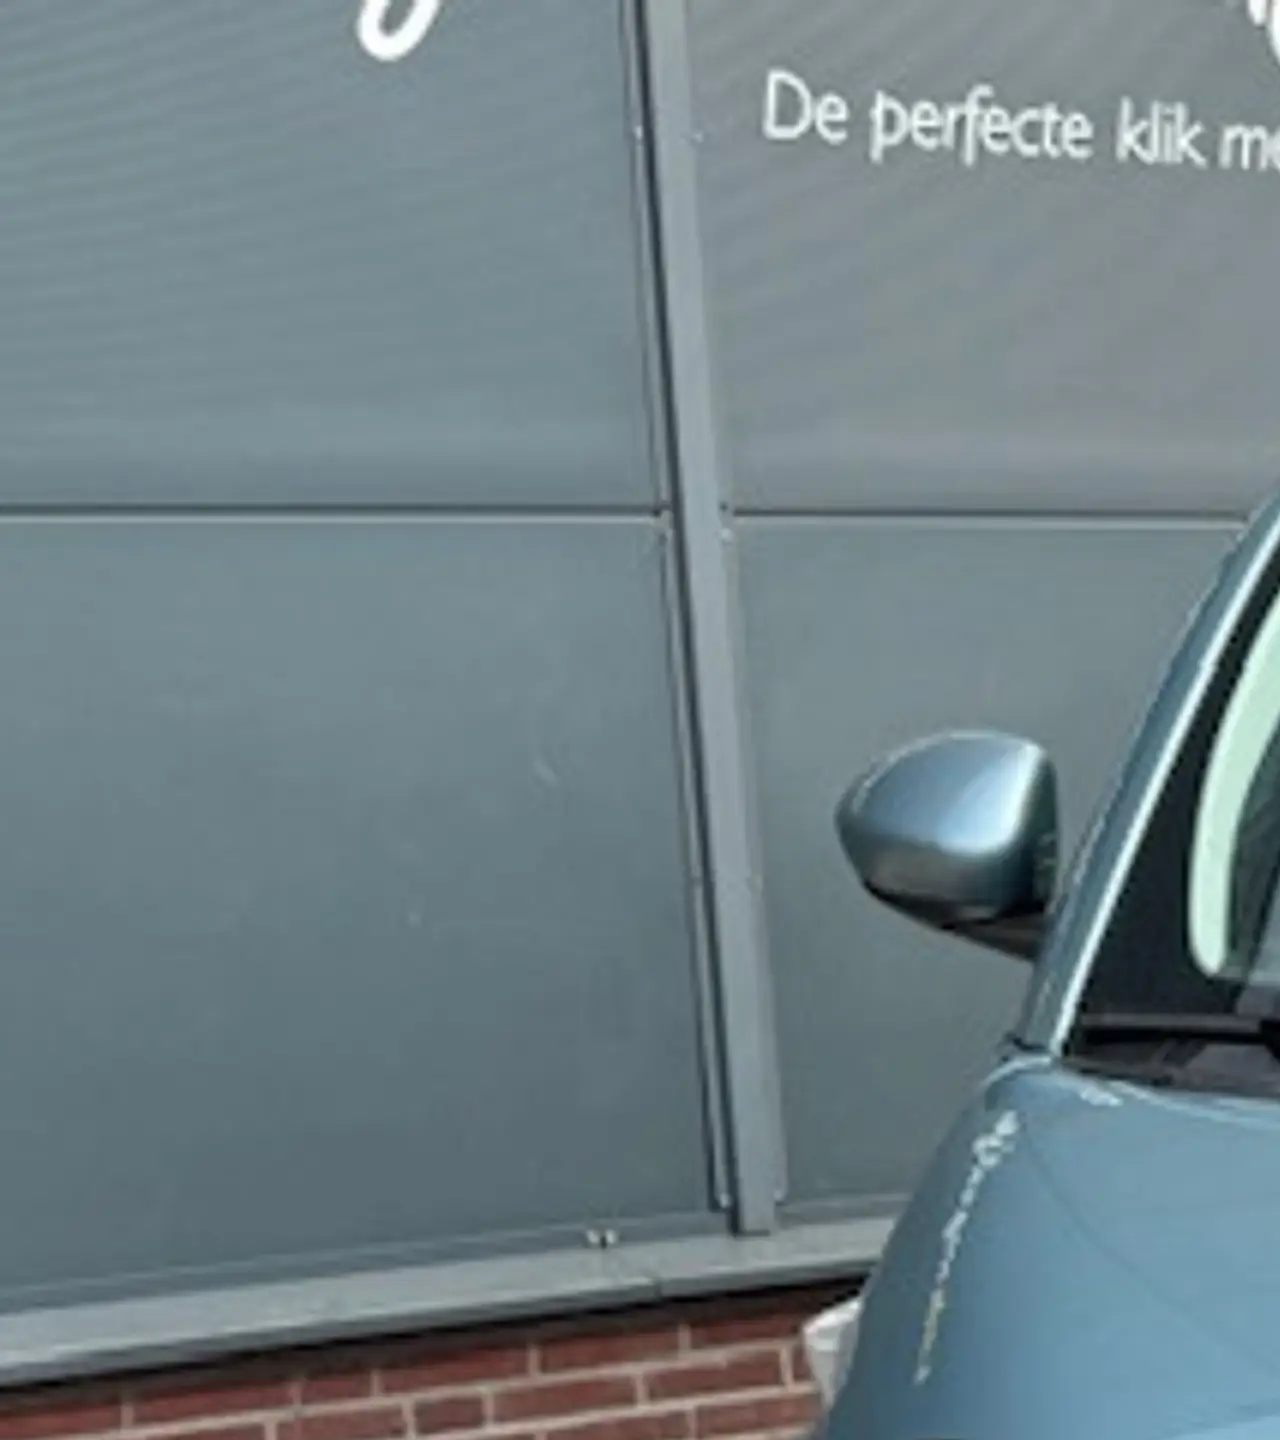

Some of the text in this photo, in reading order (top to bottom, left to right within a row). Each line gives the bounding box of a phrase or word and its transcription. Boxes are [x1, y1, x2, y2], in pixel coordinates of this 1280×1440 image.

[763, 67, 850, 145] De
[869, 83, 1095, 168] perfecte
[1114, 95, 1208, 169] klik
